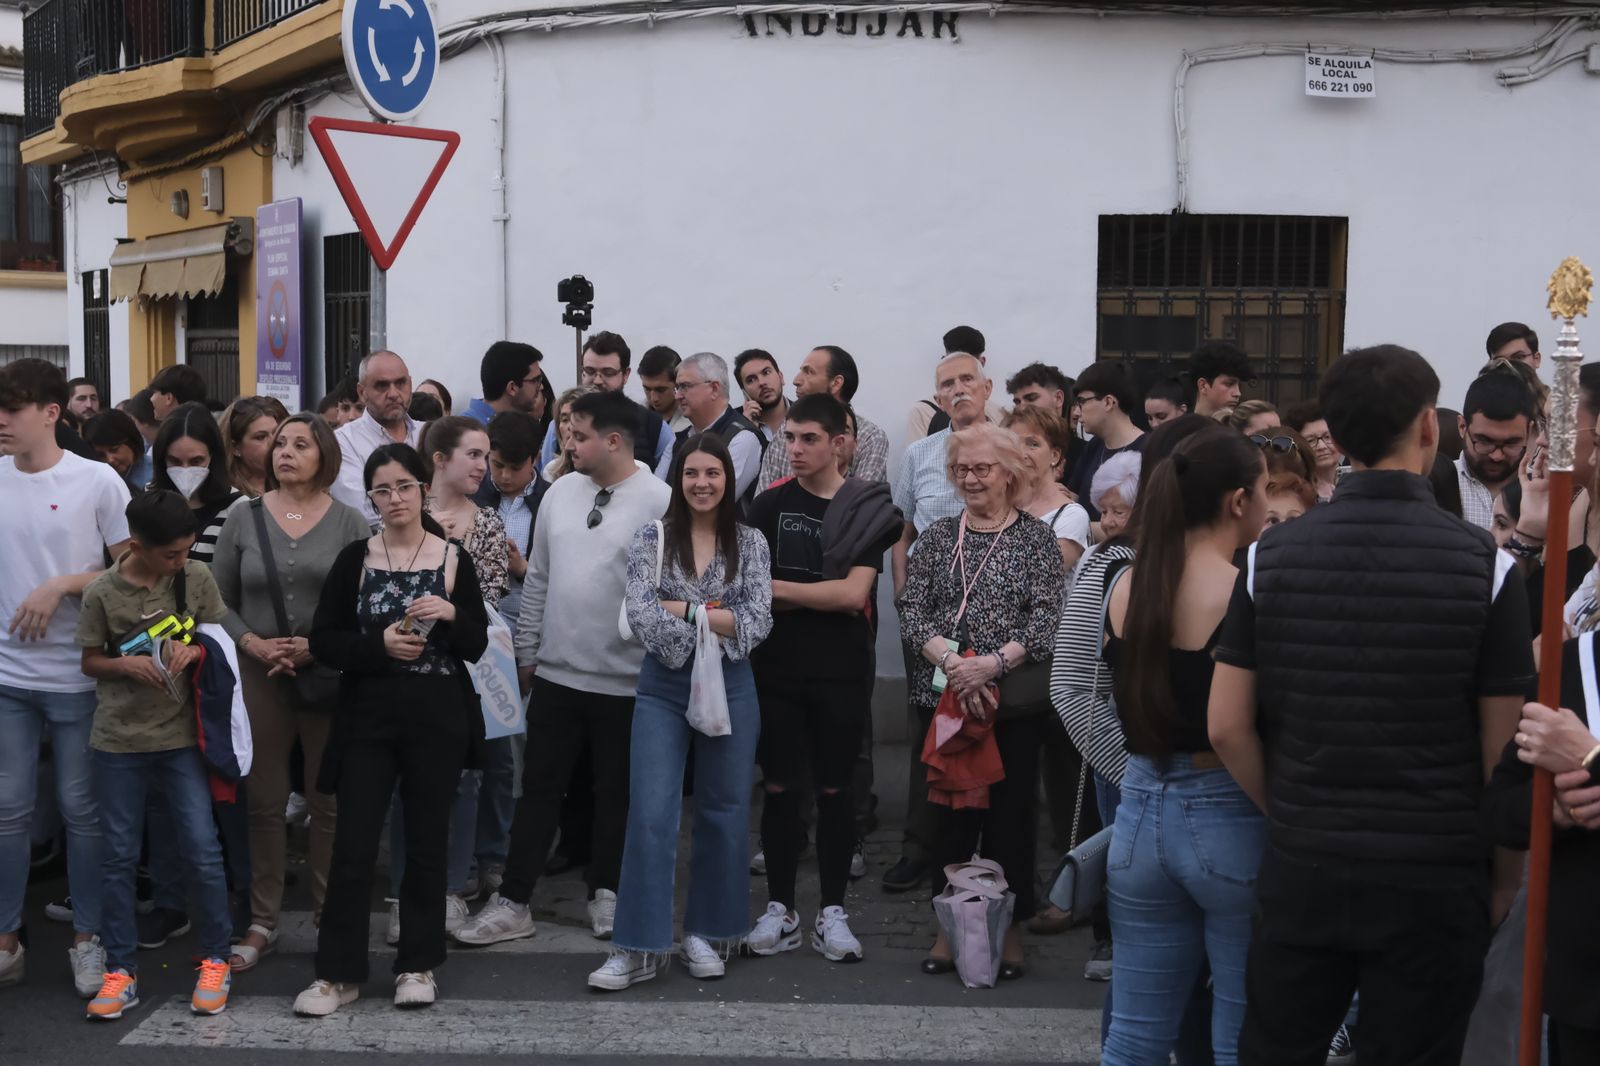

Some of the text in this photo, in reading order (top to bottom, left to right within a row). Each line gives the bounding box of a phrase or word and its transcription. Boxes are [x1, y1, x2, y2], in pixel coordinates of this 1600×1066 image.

[1308, 57, 1372, 69] SE ALQUILA
[1322, 68, 1358, 79] LOCAL
[1308, 80, 1373, 93] 666 221 090
